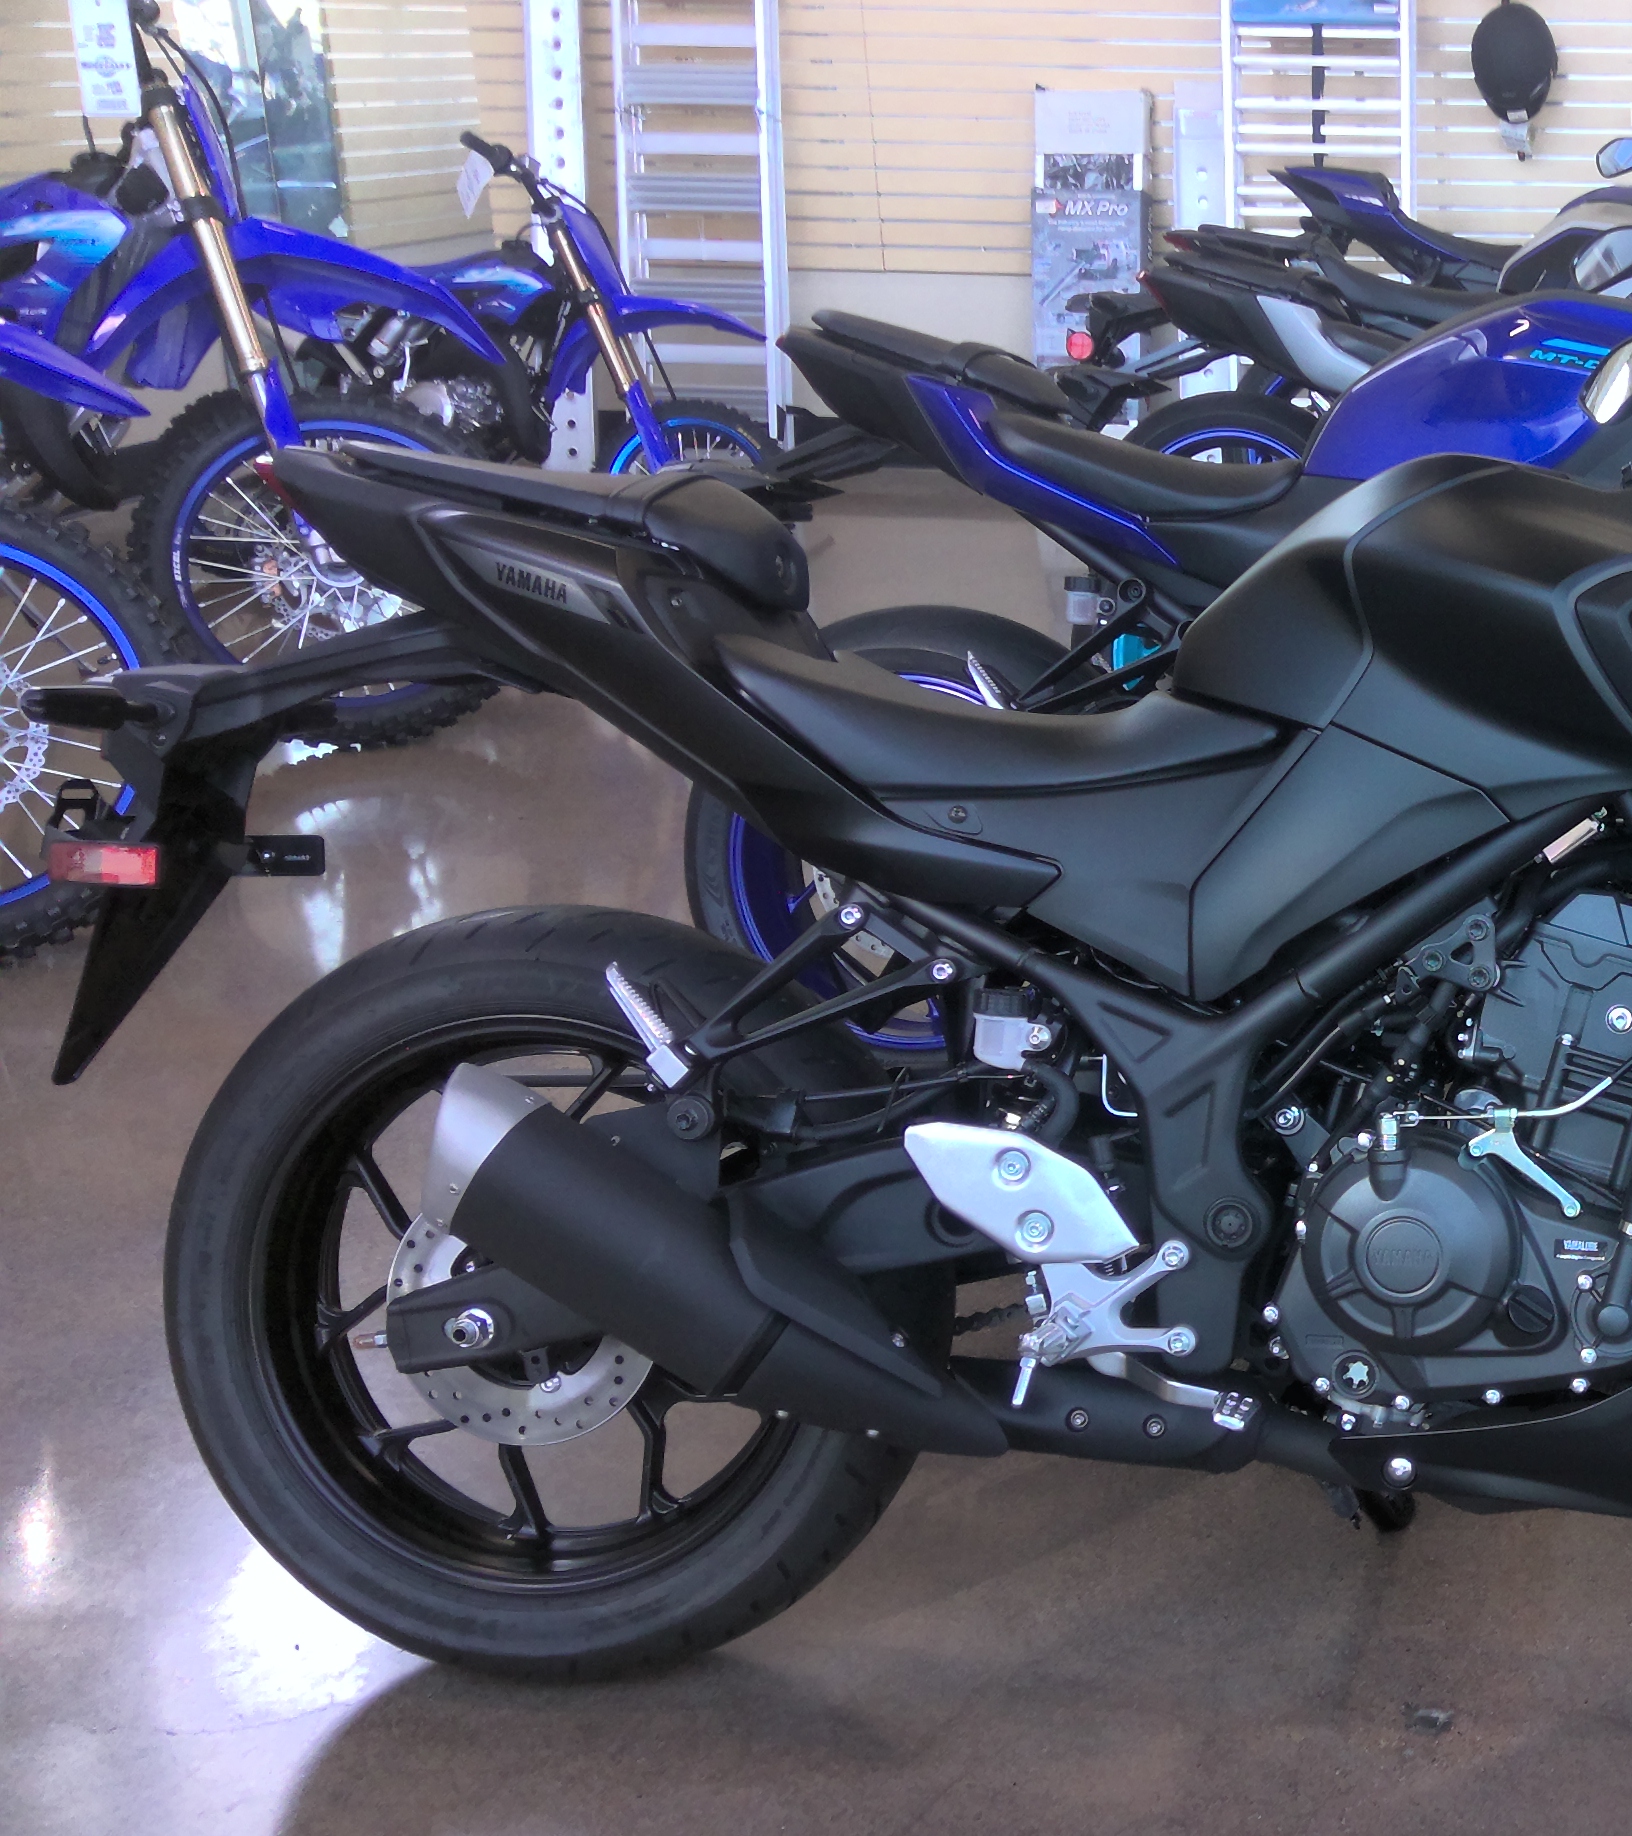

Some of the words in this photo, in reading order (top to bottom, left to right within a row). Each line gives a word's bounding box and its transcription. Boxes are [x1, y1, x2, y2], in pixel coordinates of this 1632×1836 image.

[1065, 200, 1095, 216] MX
[1096, 200, 1129, 216] Pro
[1529, 349, 1601, 370] MT-0
[495, 561, 568, 604] YAMAHA
